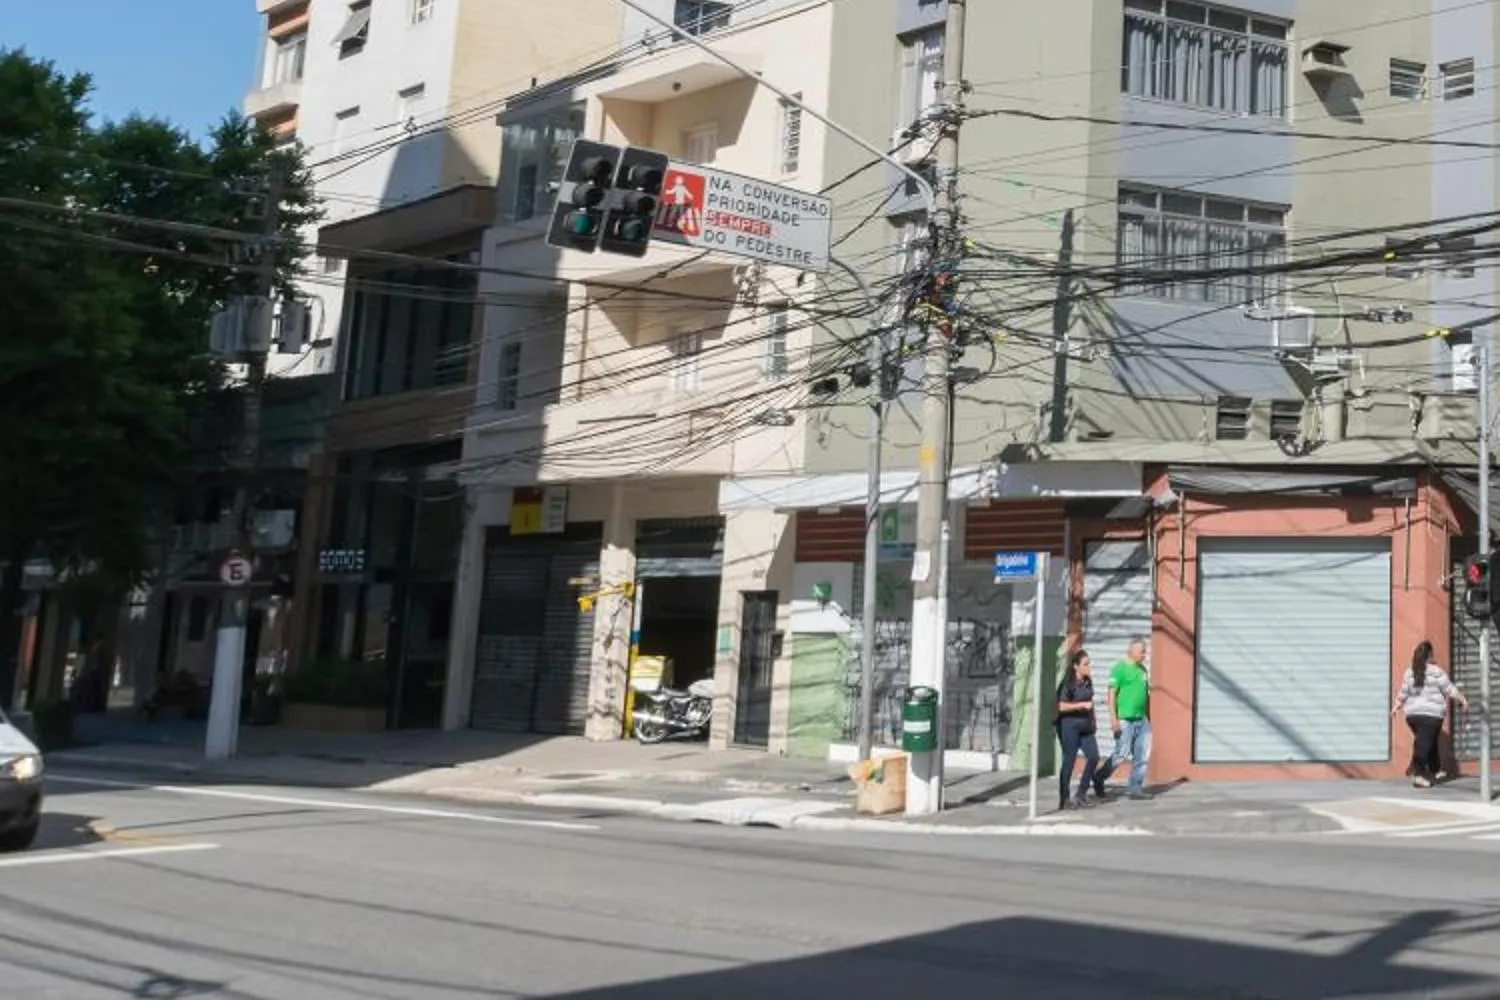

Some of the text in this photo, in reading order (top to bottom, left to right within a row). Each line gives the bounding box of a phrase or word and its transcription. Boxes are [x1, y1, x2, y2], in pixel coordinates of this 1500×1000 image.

[709, 175, 733, 191] NA
[708, 193, 801, 227] PRIORIDADE
[703, 229, 814, 265] DO PEDESTRE
